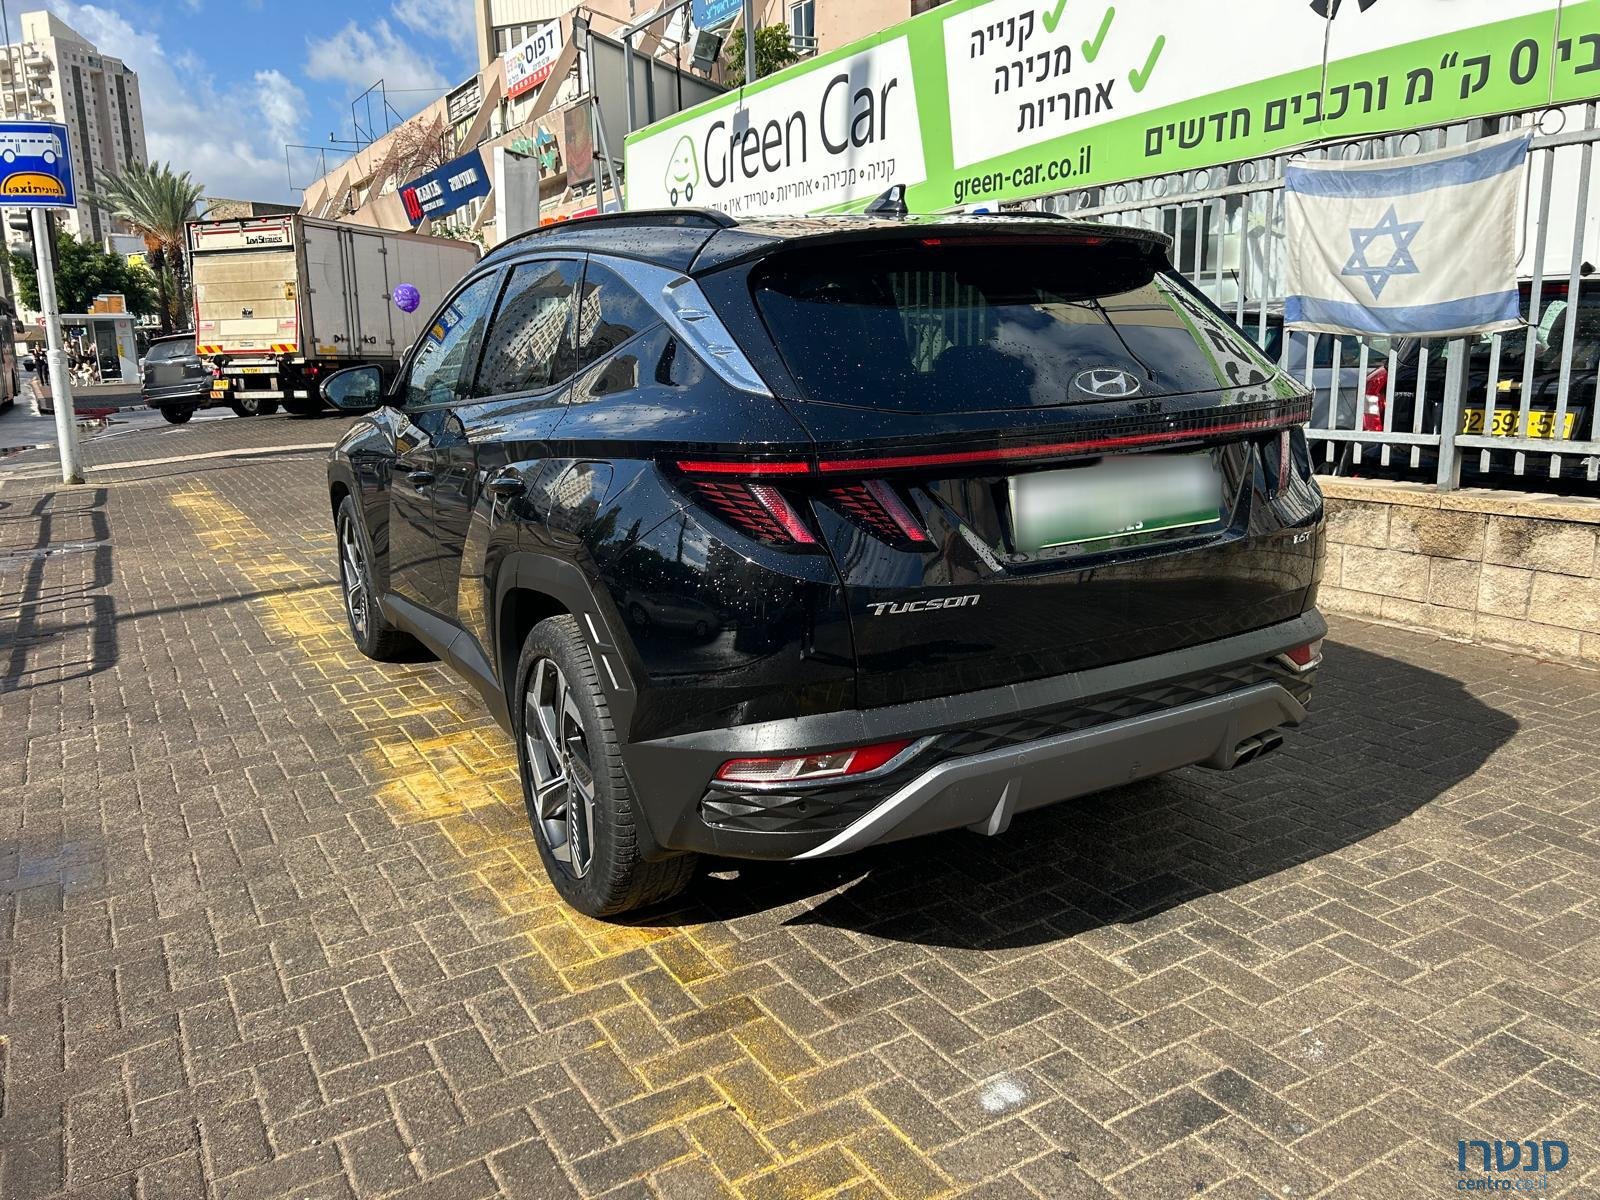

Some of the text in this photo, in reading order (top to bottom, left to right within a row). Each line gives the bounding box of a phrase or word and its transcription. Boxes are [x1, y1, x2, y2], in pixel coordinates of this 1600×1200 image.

[525, 29, 554, 64] דפוס
[970, 9, 1034, 58] קנייה
[994, 44, 1071, 95] מכירה
[1509, 38, 1539, 85] 0
[1017, 78, 1115, 133] אחריות
[1263, 75, 1388, 133] ורכבים
[704, 73, 898, 188] Green Car
[1144, 107, 1251, 158] חדשים
[8, 181, 32, 194] taxi
[34, 186, 60, 194] מונית
[776, 178, 812, 203] אחריות
[822, 167, 856, 192] מכירה
[867, 158, 896, 182] קניה
[953, 145, 1092, 204] green-car.co.il
[729, 196, 741, 216] אין
[744, 190, 768, 209] טרייד
